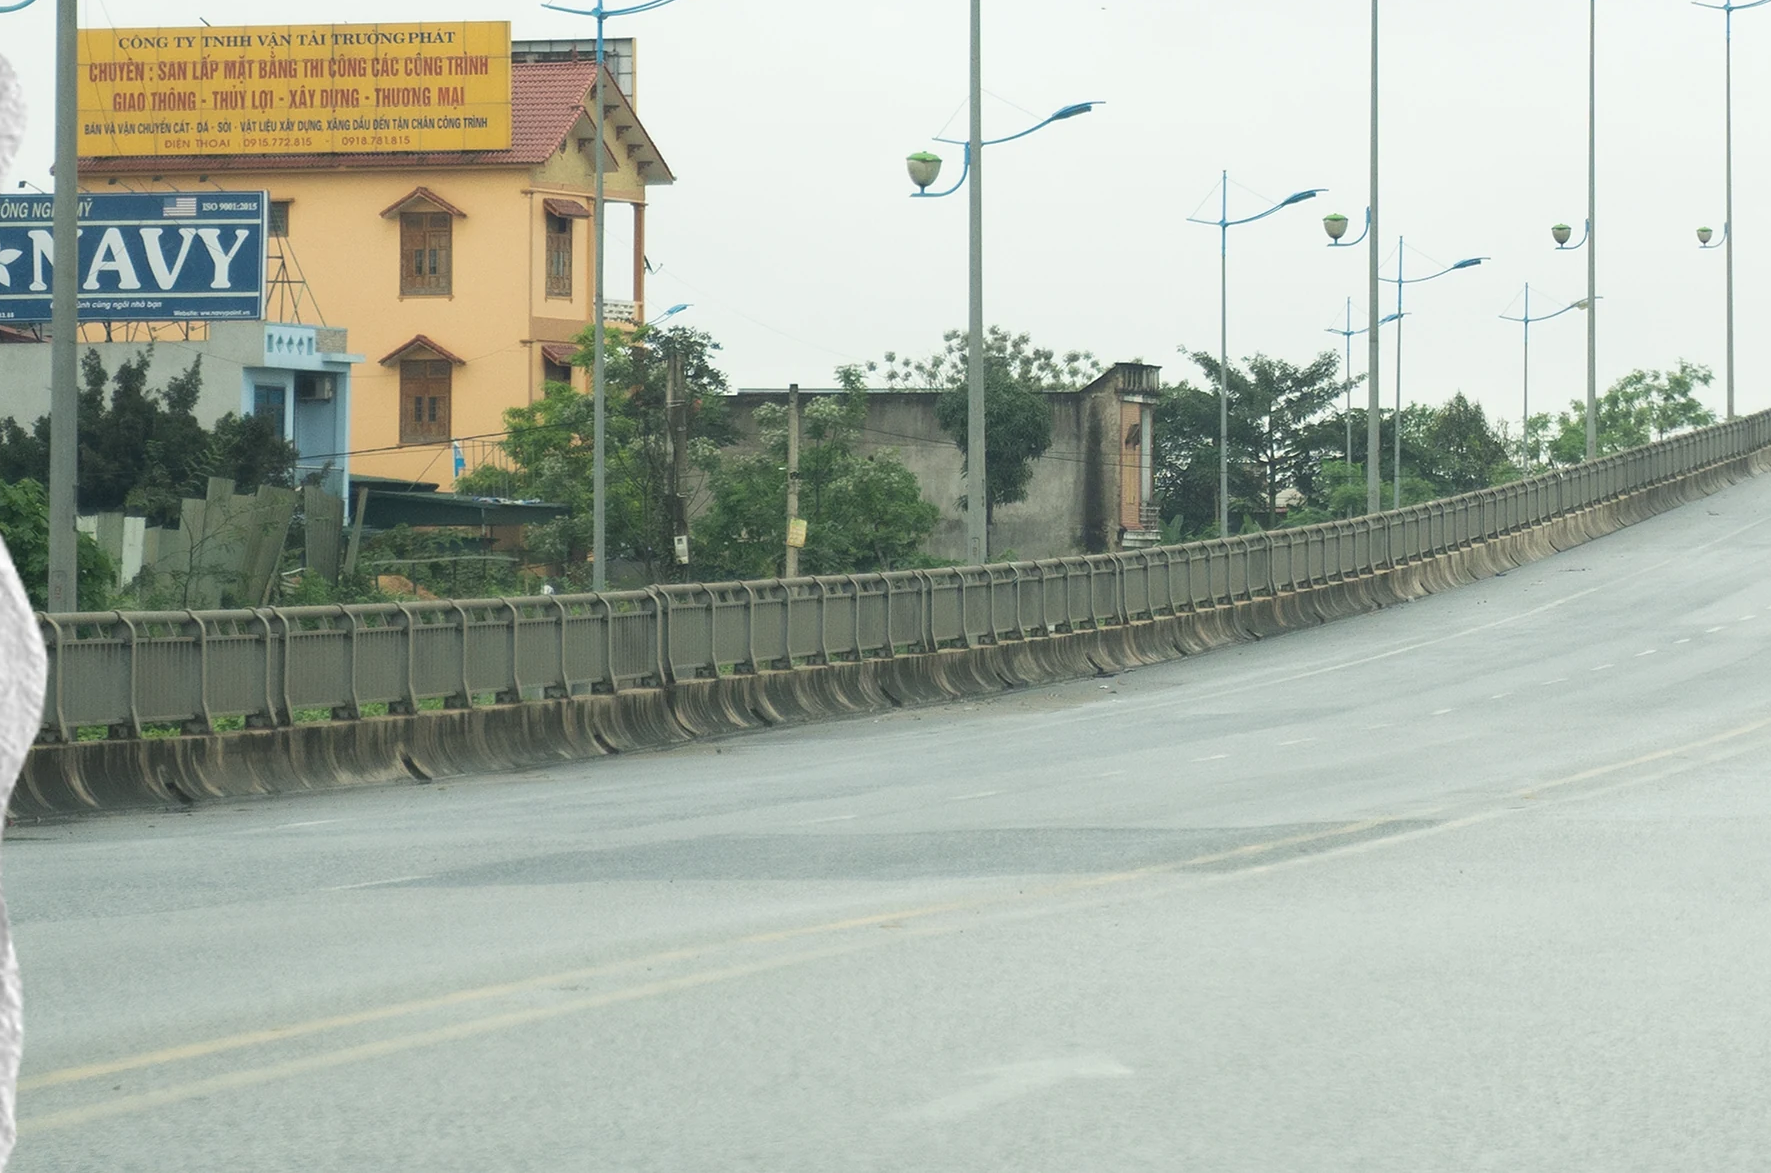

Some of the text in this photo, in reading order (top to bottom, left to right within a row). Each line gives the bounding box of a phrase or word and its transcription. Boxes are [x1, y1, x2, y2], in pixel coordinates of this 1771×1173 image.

[118, 34, 169, 50] CÔNG
[173, 36, 196, 48] TY
[202, 35, 252, 47] TNHH
[257, 32, 291, 51] VẬN
[408, 28, 456, 44] PHÁT
[89, 57, 145, 82] CHUYÊN
[157, 60, 187, 81] SAN
[192, 54, 219, 81] LẤP
[223, 55, 255, 84] MẶT
[258, 50, 298, 79] BẰNG
[302, 58, 324, 78] THI
[328, 53, 367, 78] CÔNG
[371, 52, 400, 77] CÁC
[404, 52, 443, 77] CÔNG
[446, 51, 489, 76] TRÌNH
[112, 92, 146, 112] GIAO
[150, 87, 197, 112] THÔNG
[212, 84, 247, 111] THỦY
[251, 89, 274, 114] LỢI
[288, 85, 316, 109] XÂY
[320, 88, 360, 113] DỰNG
[437, 86, 465, 111] MẠI
[463, 114, 488, 128] TRÌNH
[243, 137, 313, 149] 0915.772.815
[341, 136, 411, 146] 0918.781.815
[202, 202, 258, 211] ISO 9001:2015
[27, 227, 250, 291] NAVY
